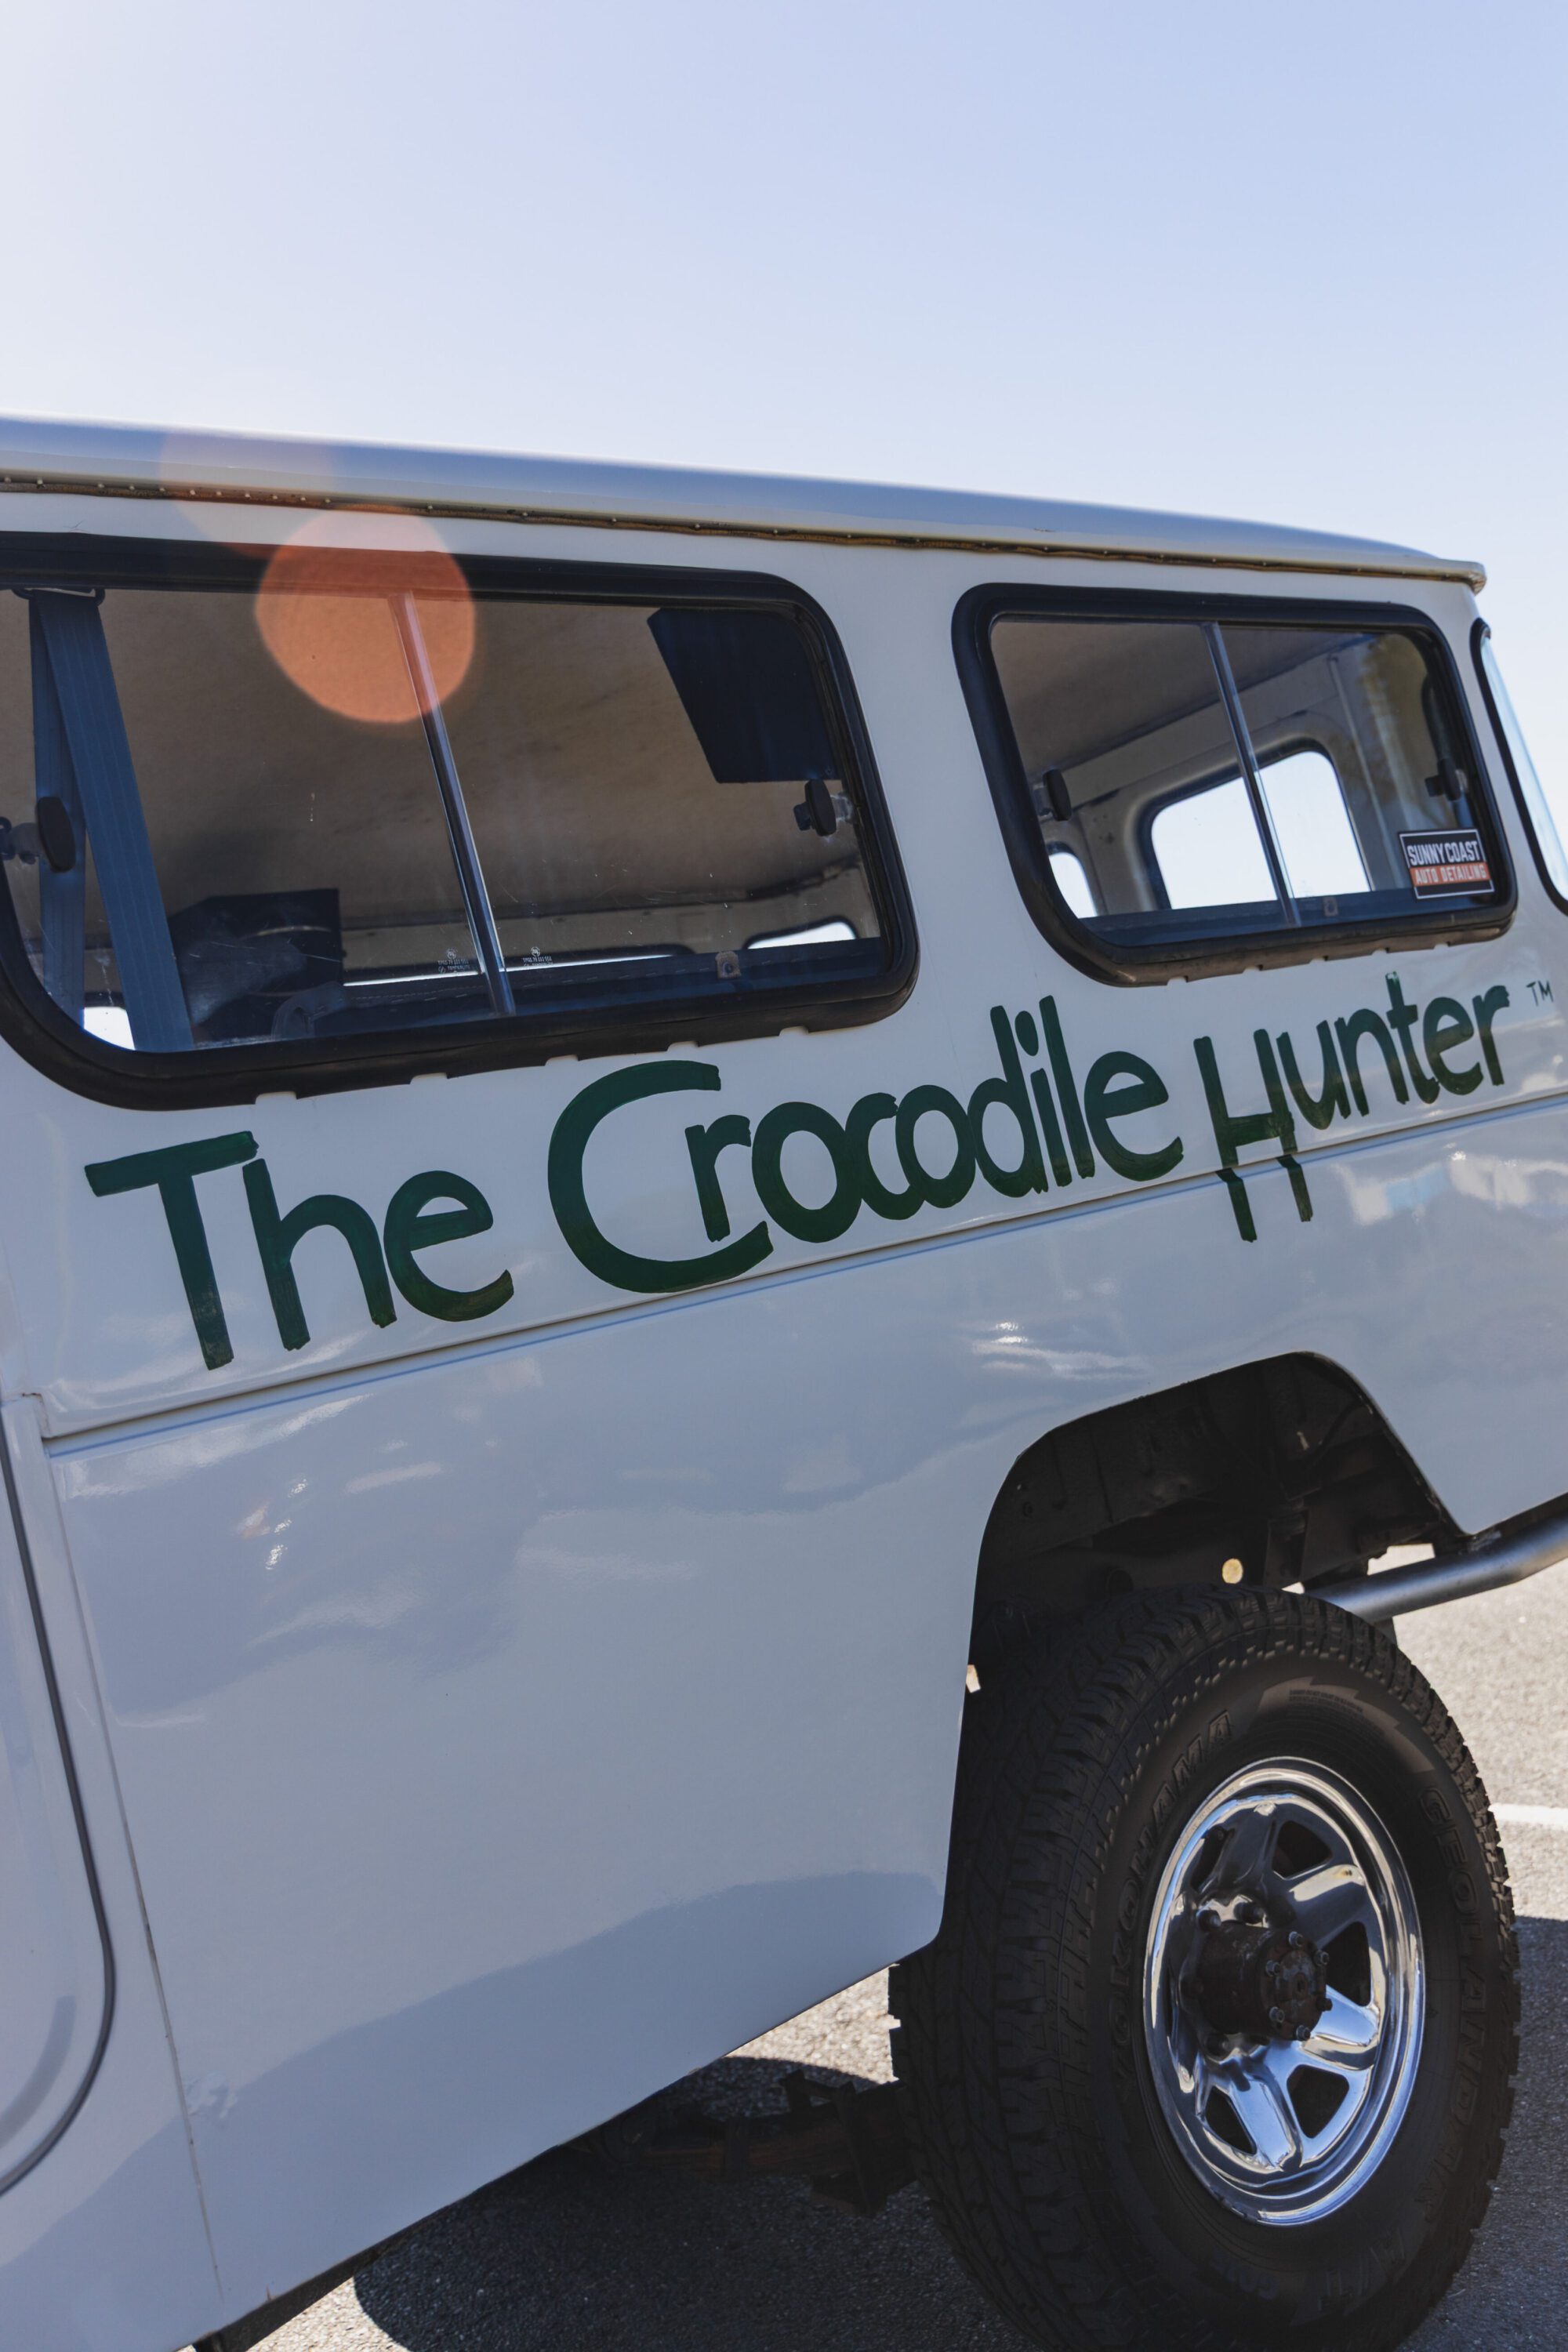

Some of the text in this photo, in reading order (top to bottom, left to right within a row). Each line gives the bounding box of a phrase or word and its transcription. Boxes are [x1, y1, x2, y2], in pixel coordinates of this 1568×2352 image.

[1407, 841, 1480, 866] SUNNY COAST
[1414, 865, 1486, 884] AUTO DETAILING
[84, 1130, 514, 1370] The
[547, 994, 1184, 1294] Crocodile
[1192, 971, 1510, 1243] Hunter
